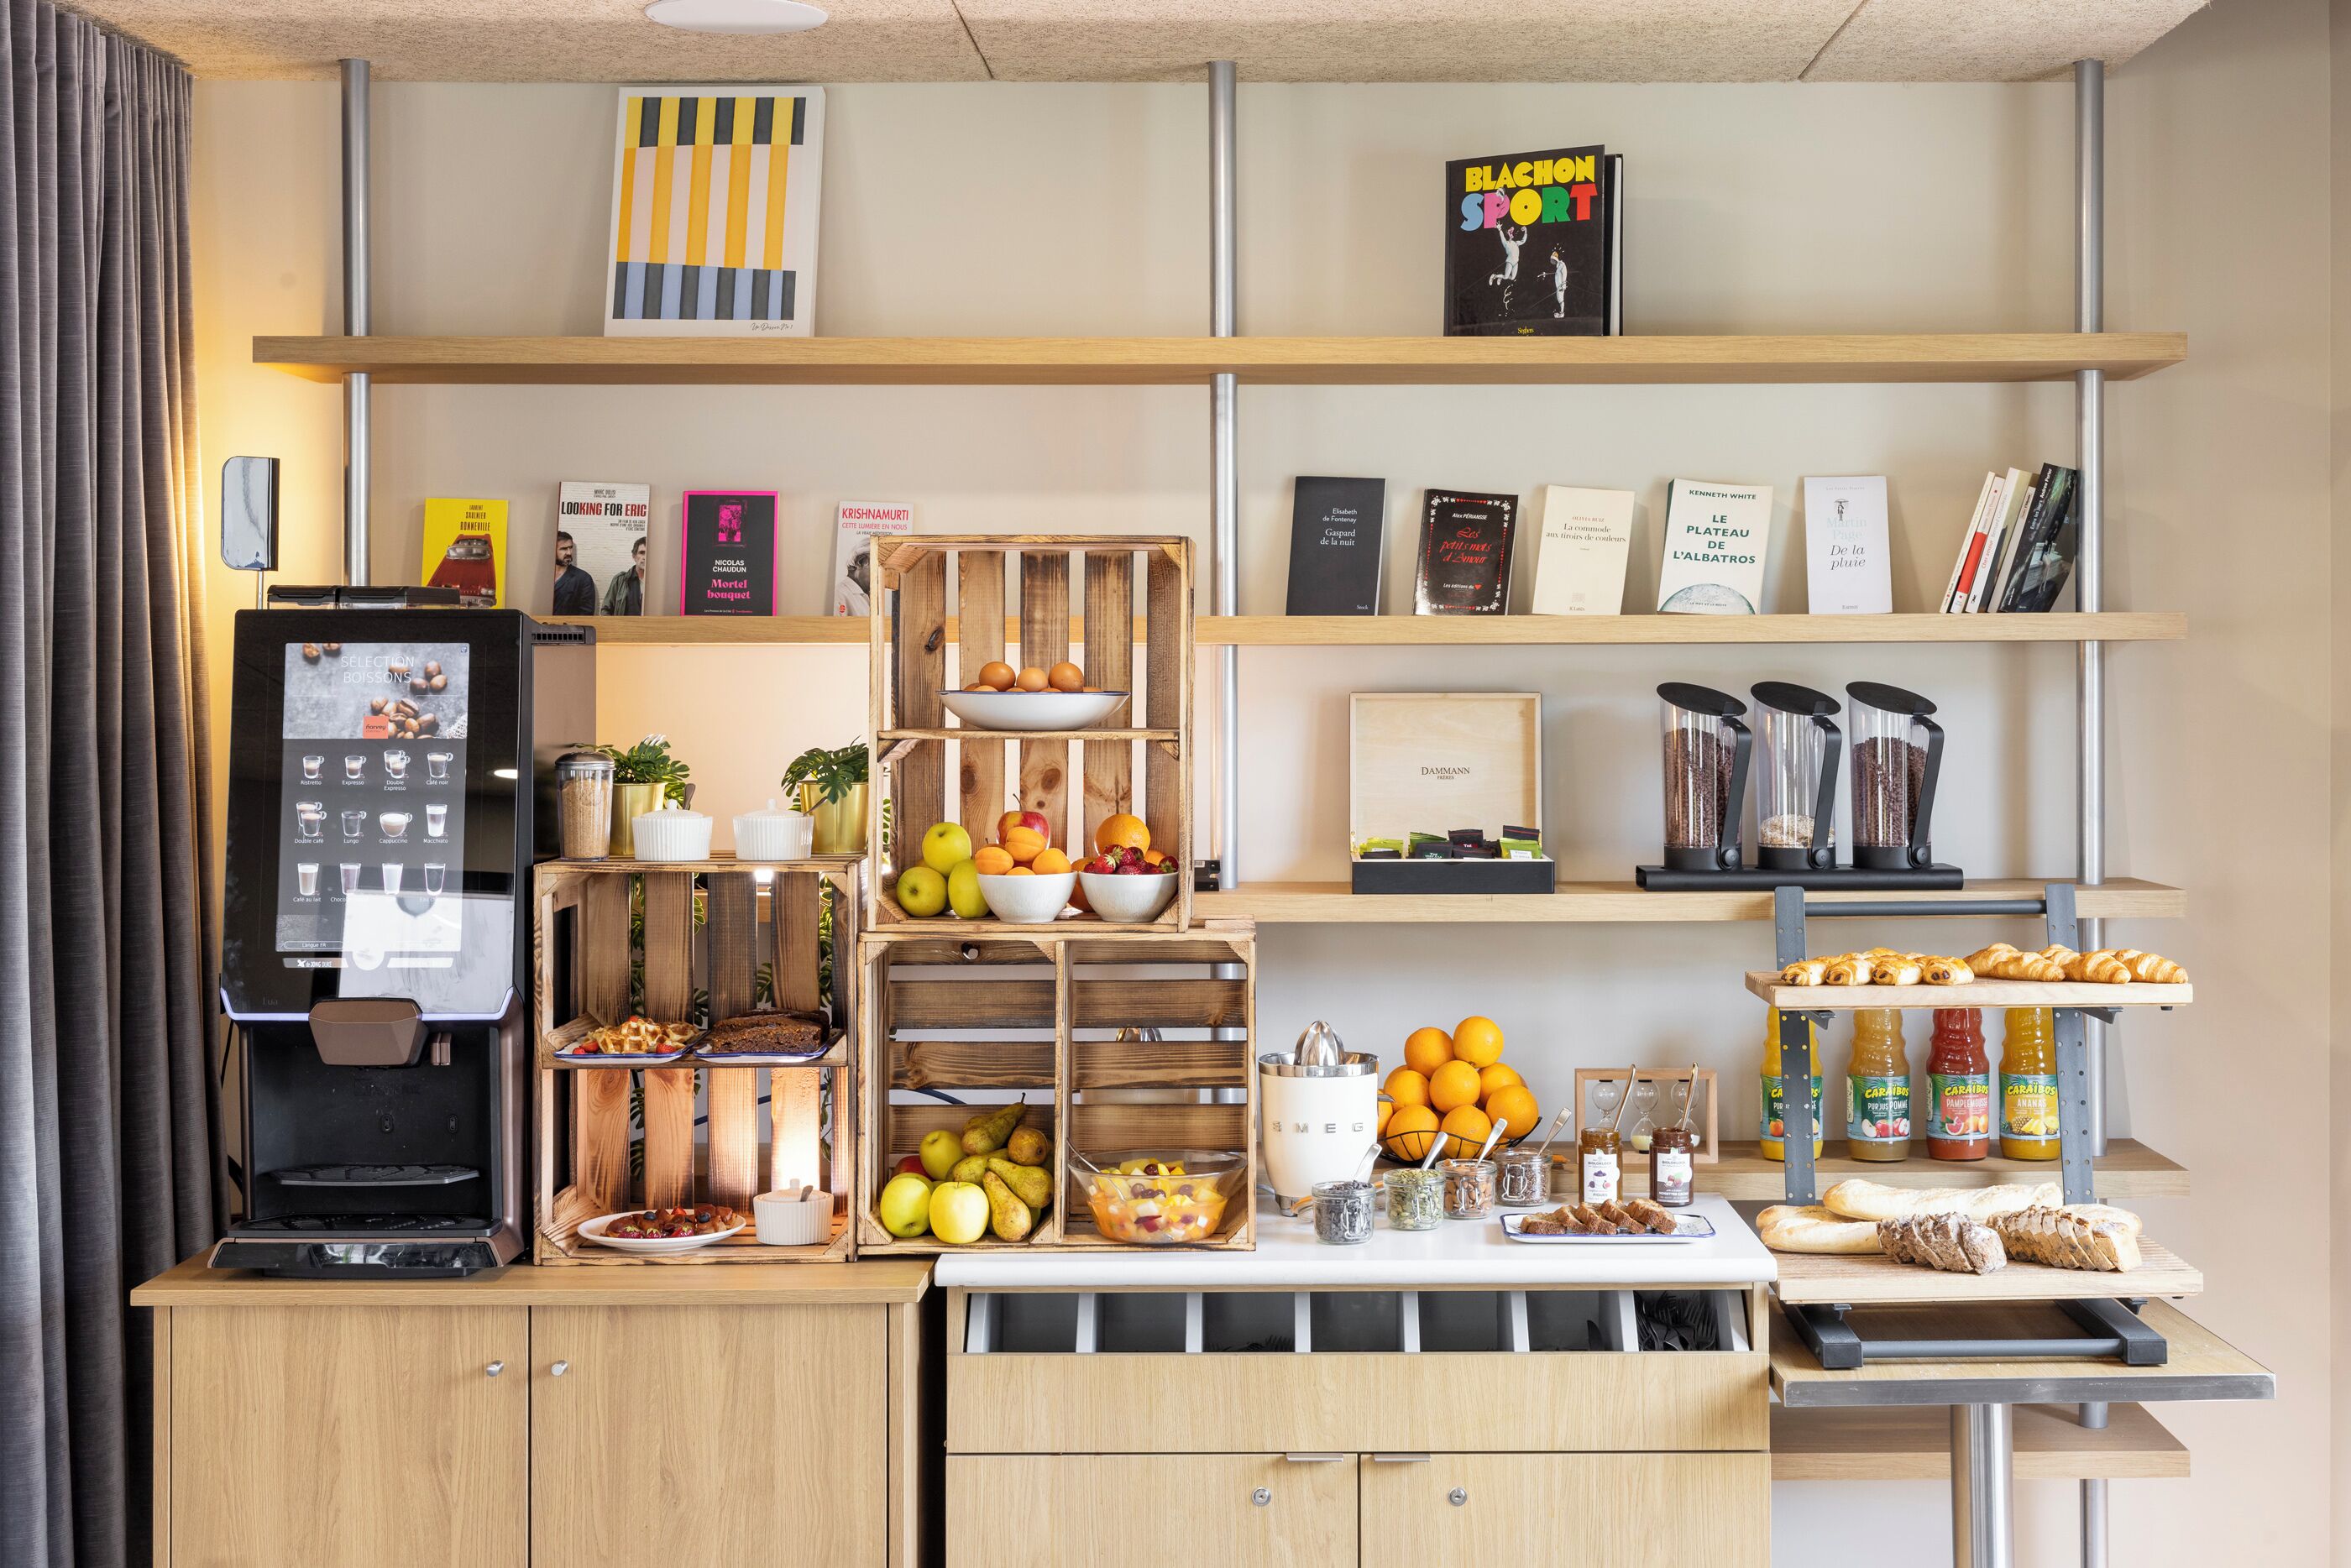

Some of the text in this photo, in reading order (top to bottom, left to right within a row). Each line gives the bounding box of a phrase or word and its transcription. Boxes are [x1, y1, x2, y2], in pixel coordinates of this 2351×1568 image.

[1466, 155, 1595, 192] BLACHON
[1460, 183, 1598, 231] SPORT
[1689, 490, 1728, 498] KENNETH
[2040, 481, 2048, 499] Andrew
[561, 502, 647, 517] LOOKING FOR ERIC
[842, 508, 909, 520] KRISHNAMURTI
[1331, 515, 1357, 524] Fontenay
[1712, 514, 1727, 524] LE
[1827, 517, 1867, 528] Martin
[460, 521, 490, 531] BONNEVILLE
[1686, 525, 1750, 537] PLATEAU
[1325, 528, 1356, 538] Gaspard
[1457, 527, 1479, 538] Les
[1833, 529, 1864, 541] Page
[1439, 540, 1492, 553] petits mots
[1707, 541, 1725, 550] DE
[1831, 545, 1865, 556] De la
[1443, 552, 1488, 564] d'Amour
[1673, 551, 1756, 564] L'ALBATROS
[1831, 557, 1866, 570] pluie
[711, 579, 747, 588] Mortel
[707, 589, 751, 601] bouquet
[343, 672, 411, 683] BOISSONS
[1421, 767, 1470, 775] DAMMANN
[1865, 1083, 1909, 1098] CARAÏBOS
[1945, 1081, 1988, 1096] CARAÏBOS
[2008, 1081, 2056, 1096] CARAÏBOS
[1889, 1100, 1908, 1110] POMME
[2017, 1098, 2047, 1108] ANANAS
[1272, 1121, 1364, 1134] SMEG
